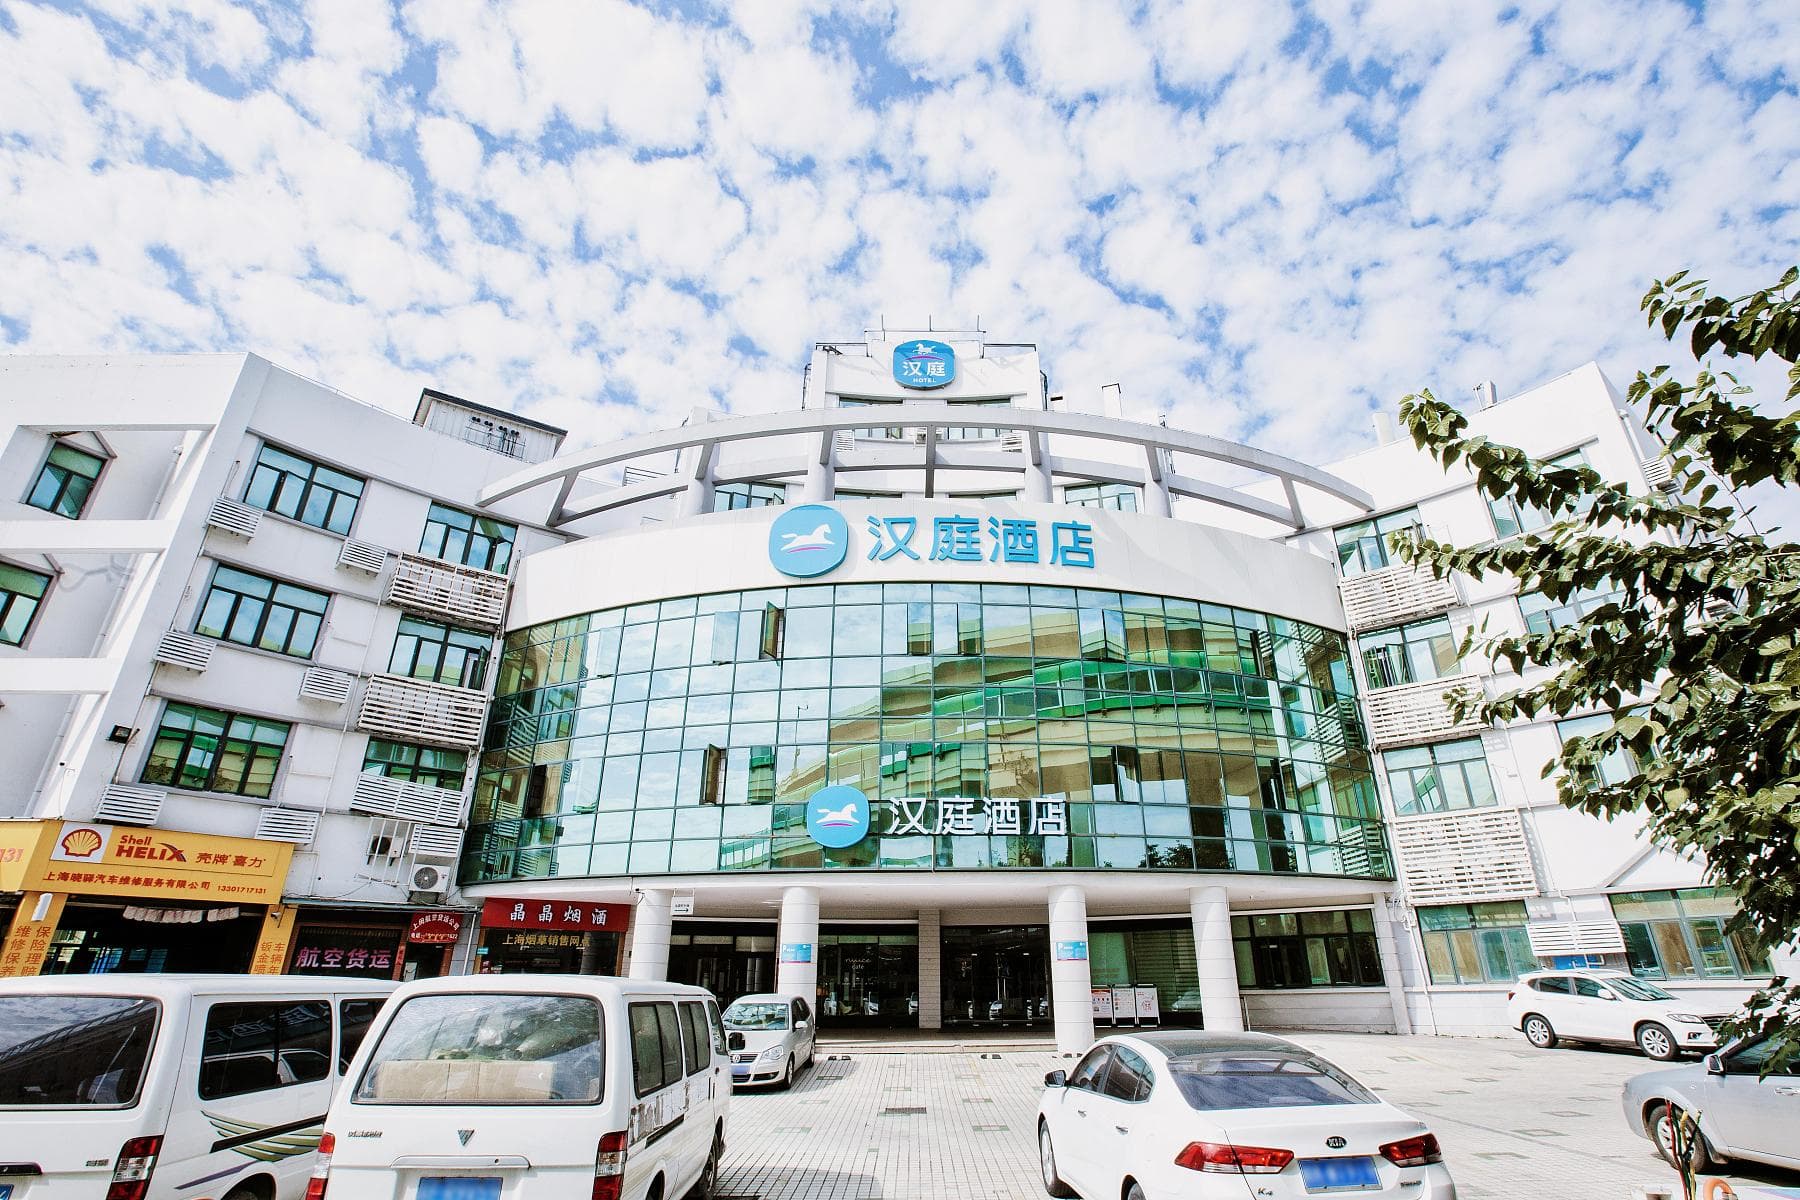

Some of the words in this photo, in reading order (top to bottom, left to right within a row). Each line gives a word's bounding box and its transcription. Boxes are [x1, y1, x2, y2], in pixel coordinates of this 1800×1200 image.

[902, 361, 946, 377] 汉庭
[867, 514, 1095, 568] 汉庭酒店
[888, 795, 1067, 836] 汉庭酒店
[119, 834, 152, 845] Shell
[115, 842, 187, 863] HELIX
[510, 903, 608, 926] 晶晶烟酒
[502, 933, 592, 948] 上海烟草销售网点
[295, 946, 392, 969] 航空货运
